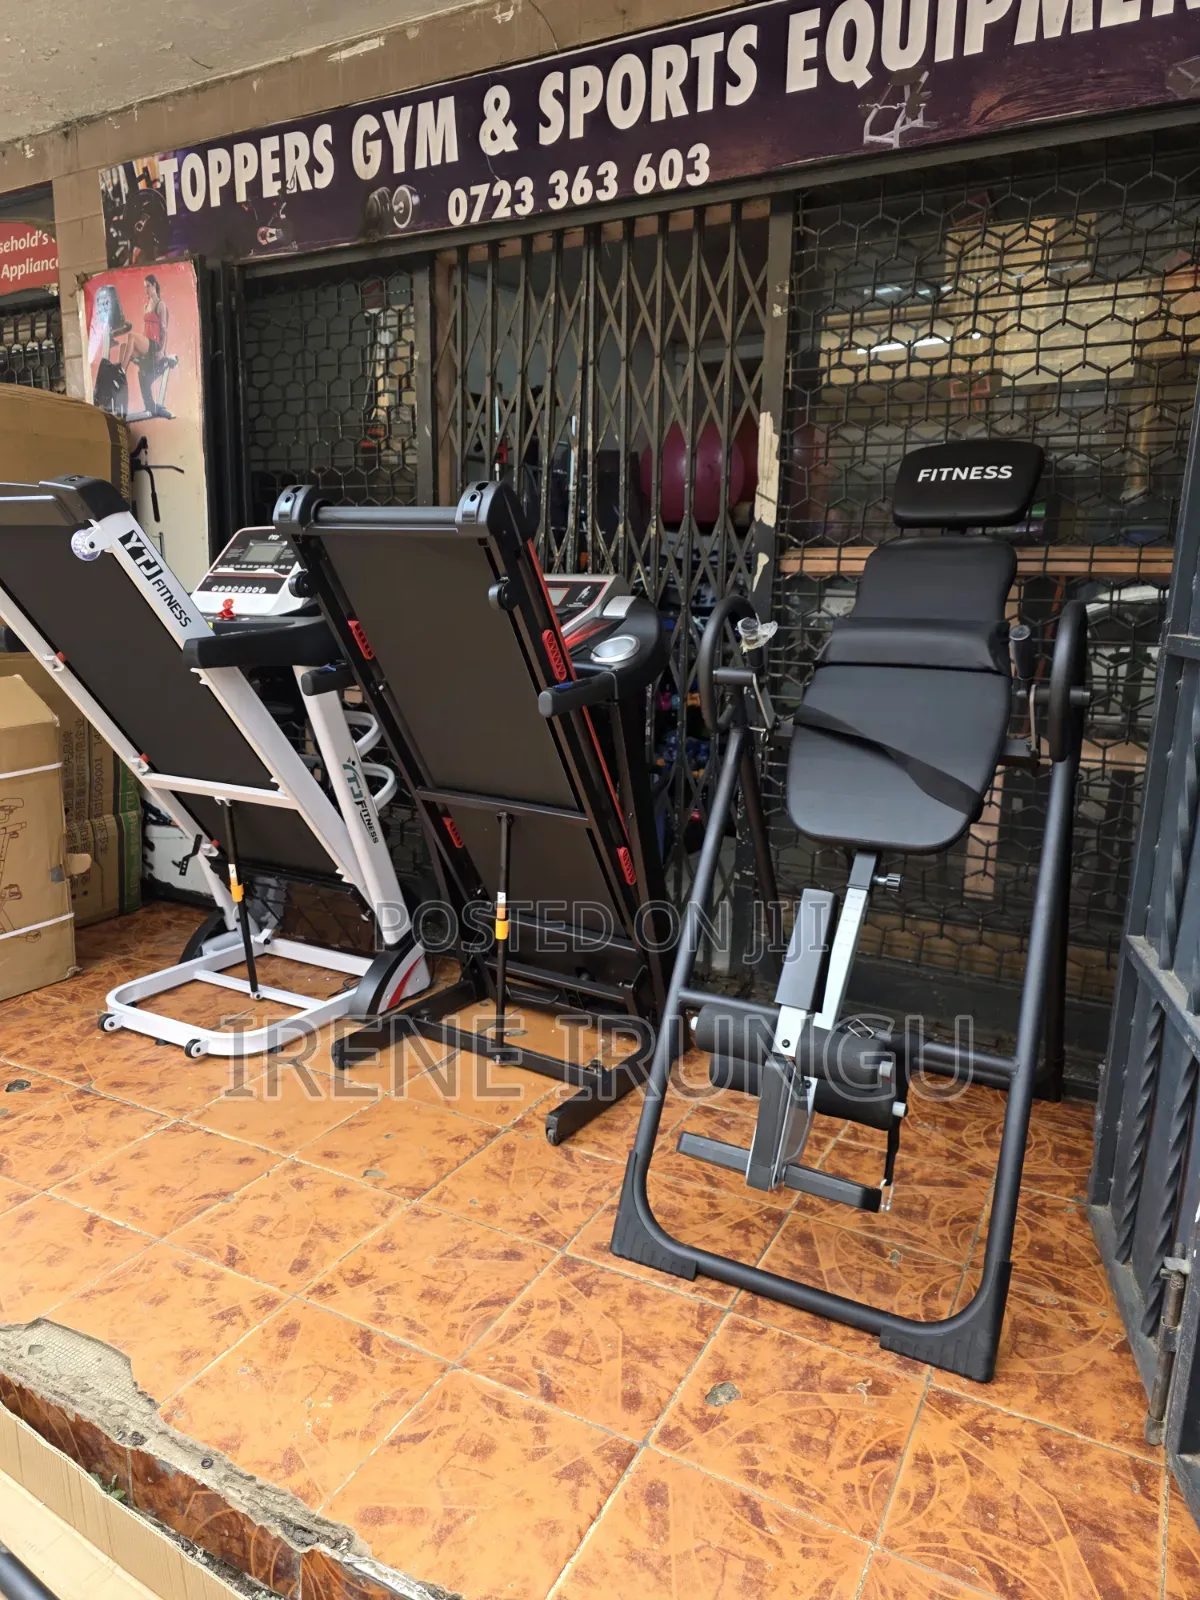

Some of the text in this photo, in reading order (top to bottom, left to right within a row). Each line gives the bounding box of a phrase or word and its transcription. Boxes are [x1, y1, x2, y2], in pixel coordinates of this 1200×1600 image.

[159, 0, 1200, 217] TOPPERS GYM & SPORTS EQUIP
[448, 143, 710, 226] 0723 363 603
[917, 465, 1013, 483] FITNESS
[151, 578, 192, 628] FITNESS
[354, 799, 379, 844] FITNESS
